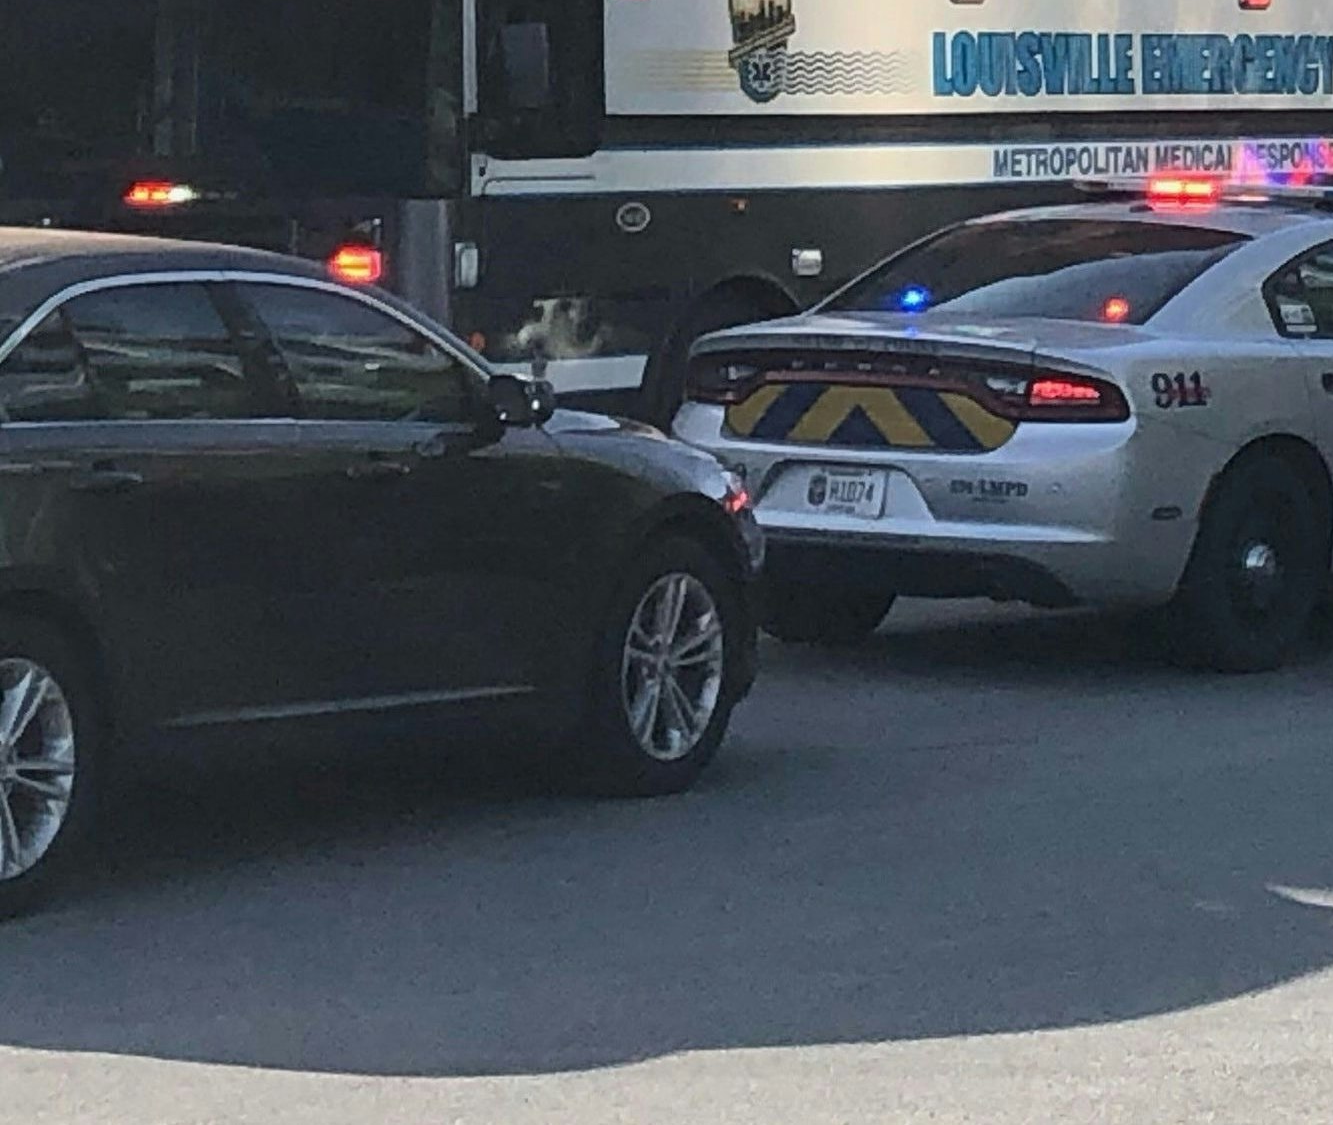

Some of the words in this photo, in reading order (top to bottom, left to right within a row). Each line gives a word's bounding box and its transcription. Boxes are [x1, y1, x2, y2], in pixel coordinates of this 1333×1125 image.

[932, 30, 1136, 98] LOUISVILLE
[993, 146, 1149, 177] METROPOLITAN
[1155, 143, 1233, 173] MEDICAL
[1151, 371, 1211, 409] 911
